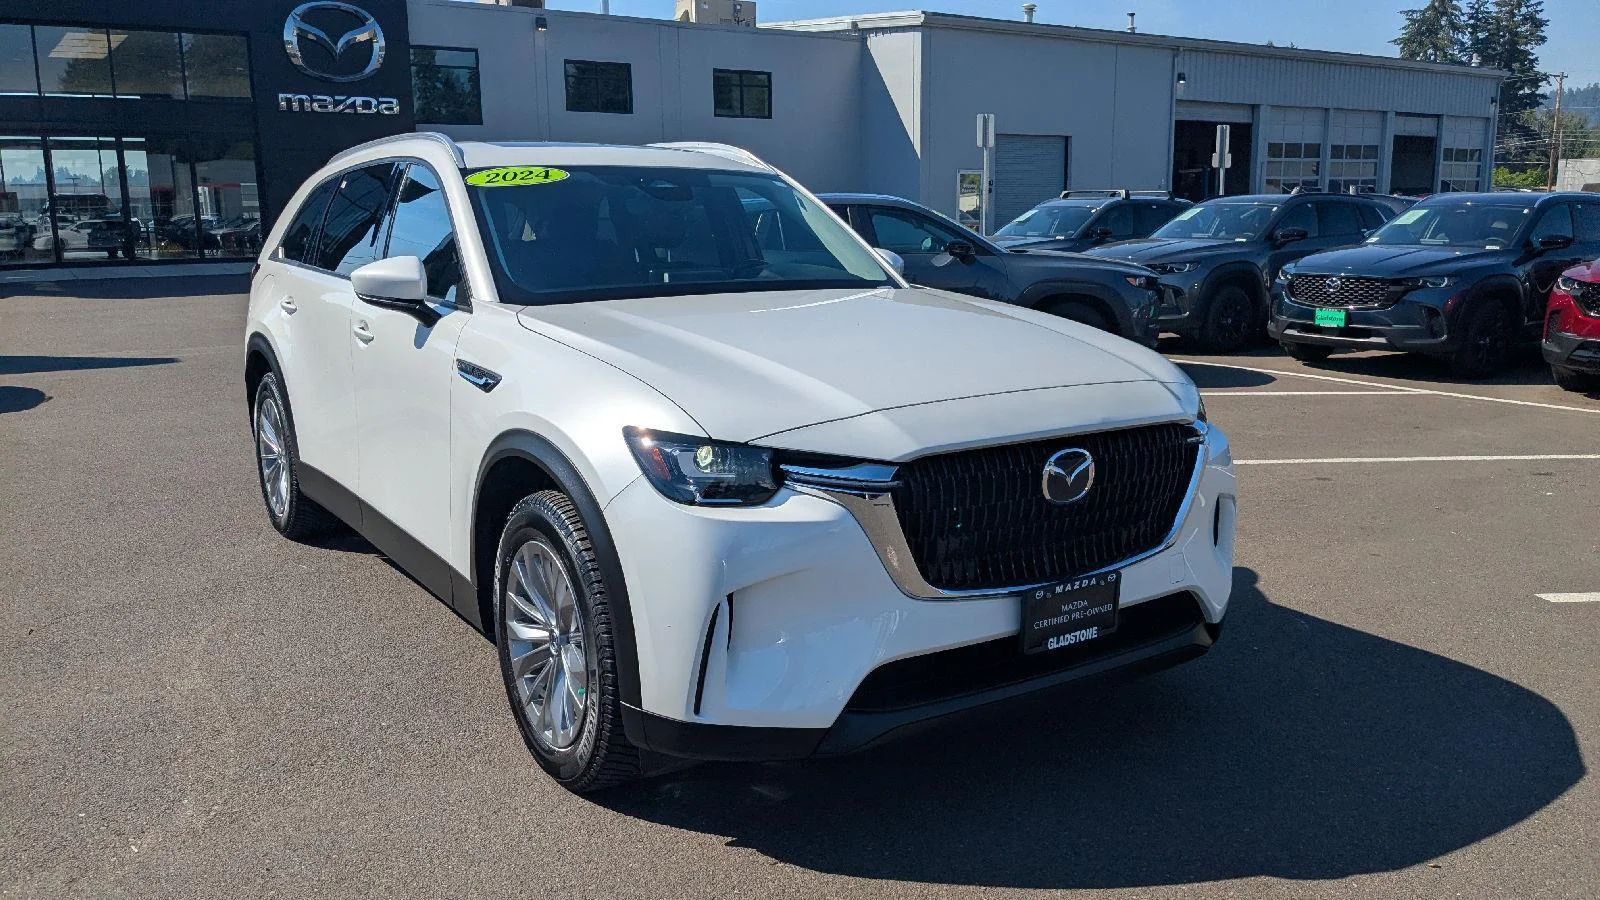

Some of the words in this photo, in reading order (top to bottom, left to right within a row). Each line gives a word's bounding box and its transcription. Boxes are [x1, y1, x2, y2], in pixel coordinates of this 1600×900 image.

[278, 93, 400, 115] mazda
[485, 169, 551, 184] 2024
[1055, 578, 1097, 594] MAZDA
[1061, 599, 1089, 613] MAZDA
[1033, 614, 1070, 630] CERTIFIED
[1071, 603, 1113, 621] PRE-OWNED
[1047, 626, 1098, 650] GLADSTONE
